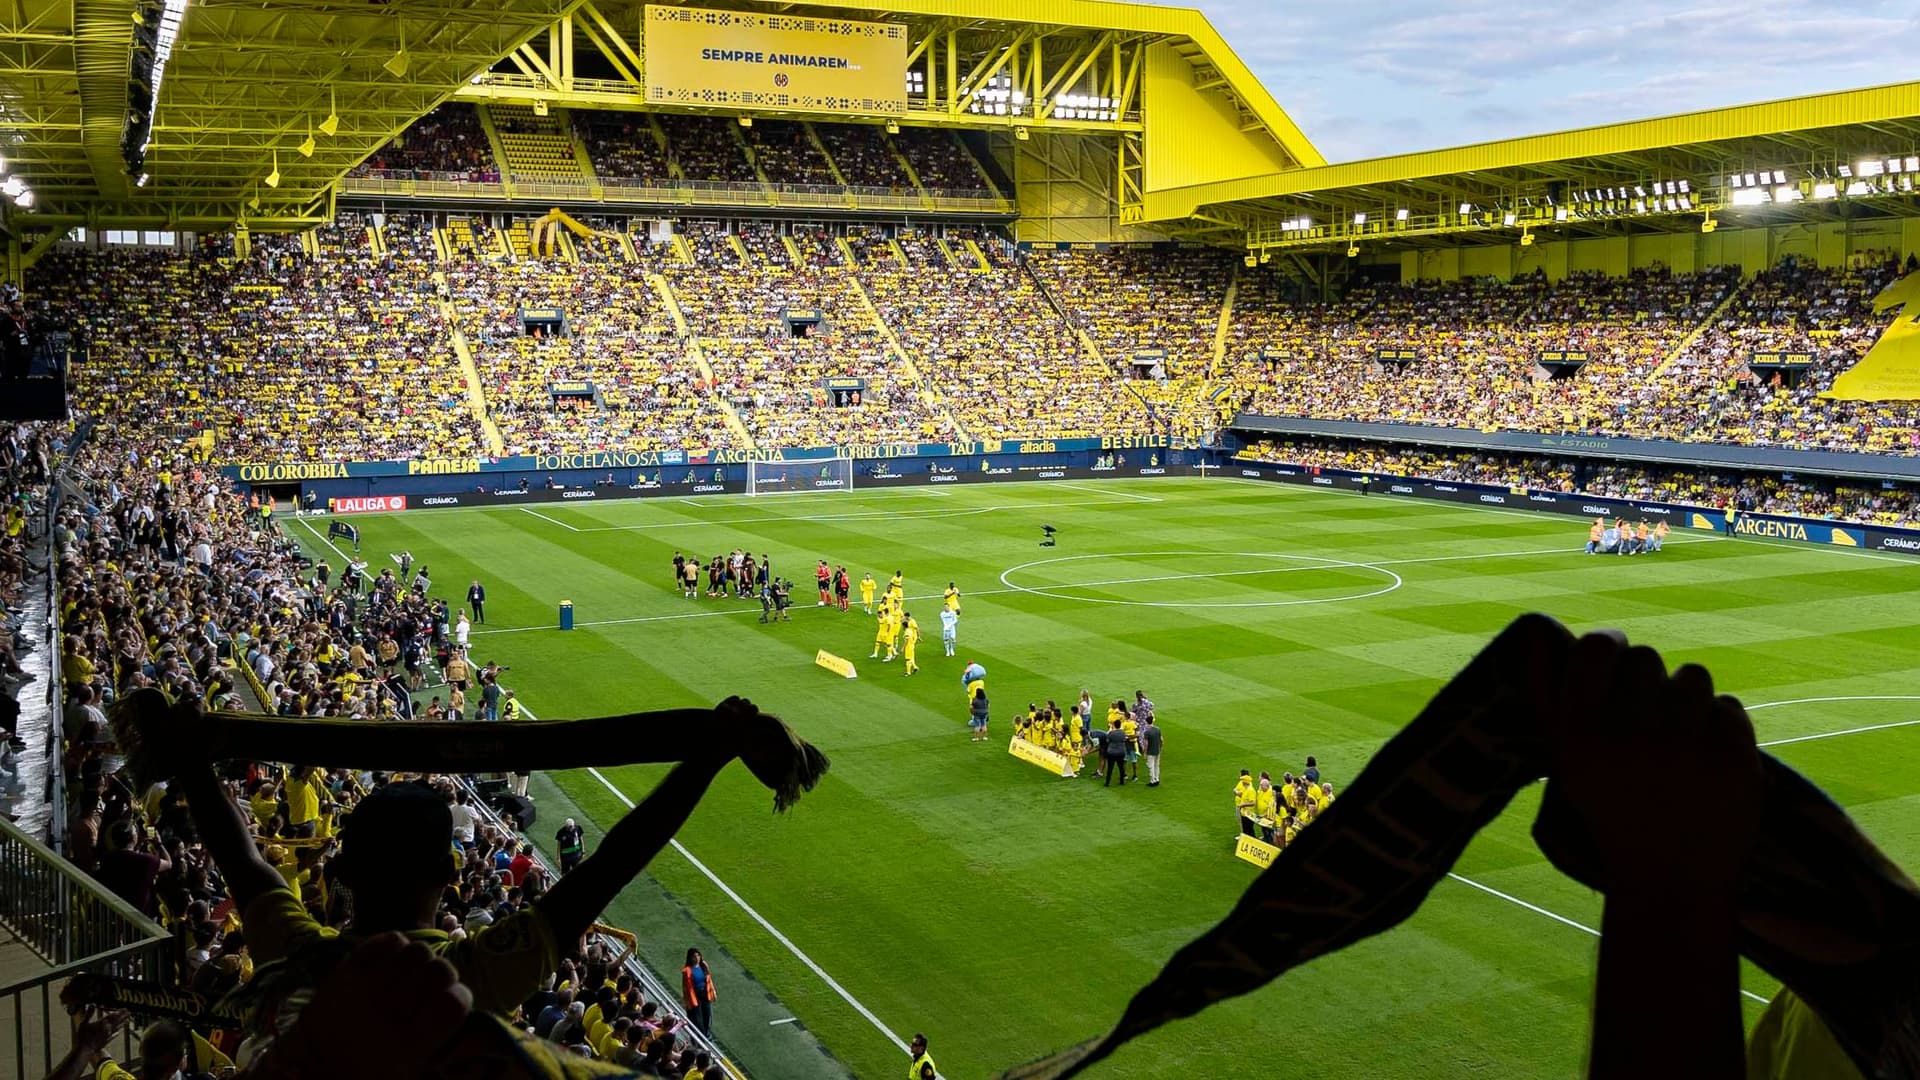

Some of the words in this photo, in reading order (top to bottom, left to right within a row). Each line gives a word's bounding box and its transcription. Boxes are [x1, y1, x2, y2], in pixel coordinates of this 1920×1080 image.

[702, 48, 764, 64] SEMPRE
[948, 441, 976, 456] TAU
[1020, 440, 1056, 453] altadia
[1101, 434, 1167, 449] BESTILE
[1560, 439, 1608, 449] ESTADIO
[535, 452, 661, 470] PORCELANOSA
[714, 448, 785, 463] ARGENTA
[239, 463, 350, 481] COLOROBBIA
[408, 458, 480, 475] PAMESA
[336, 497, 387, 512] LALIGA
[423, 496, 459, 505] CERÁMICA
[1734, 517, 1808, 541] ARGENTA
[1240, 842, 1248, 855] LA
